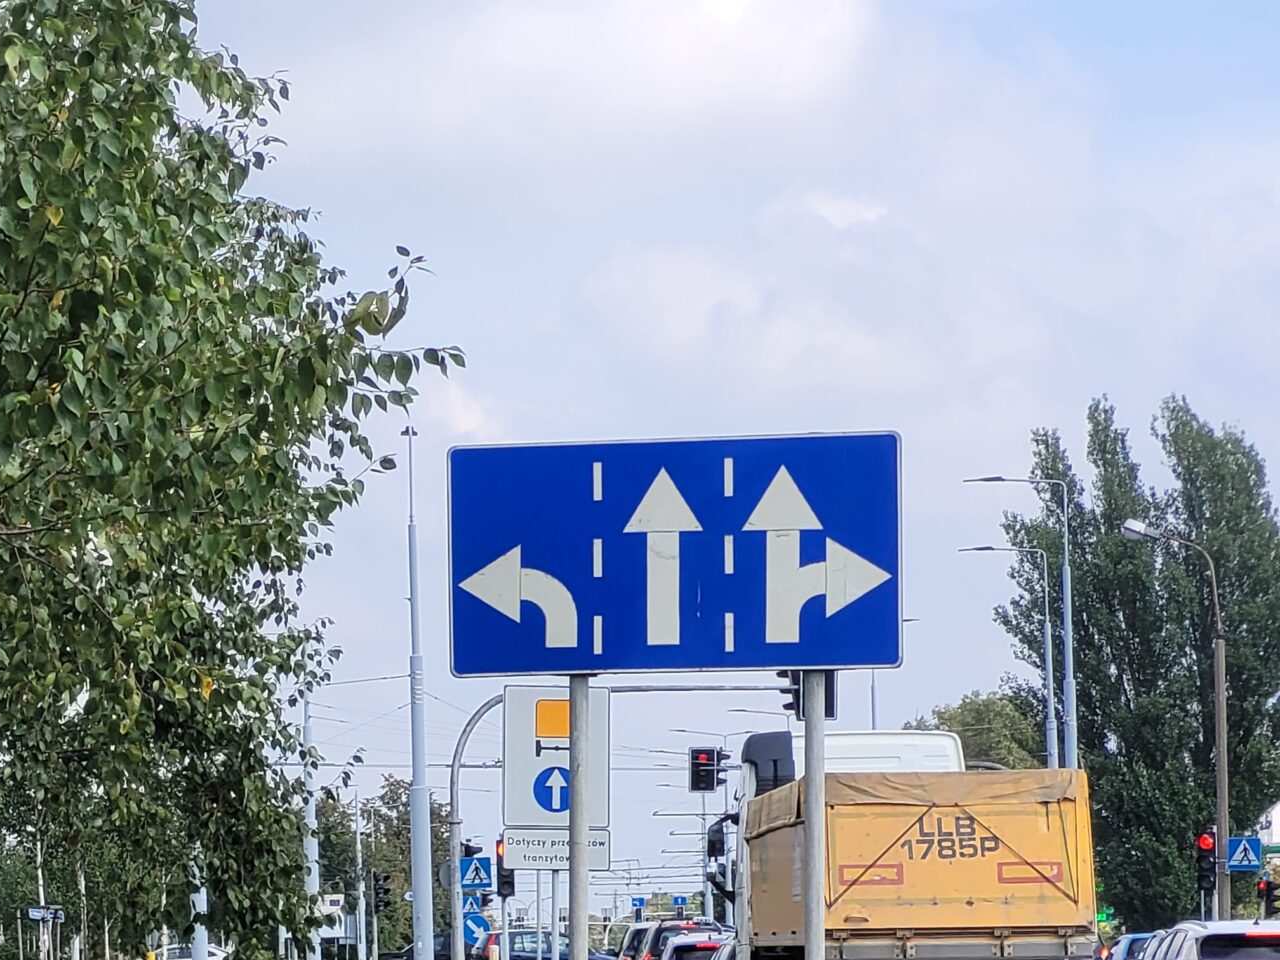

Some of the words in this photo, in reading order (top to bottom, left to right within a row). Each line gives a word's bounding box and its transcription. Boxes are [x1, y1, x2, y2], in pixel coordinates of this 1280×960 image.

[918, 816, 976, 838] LLB
[507, 836, 547, 849] Dotyczy
[900, 836, 1000, 860] 1785P
[523, 853, 570, 865] tranzytow
